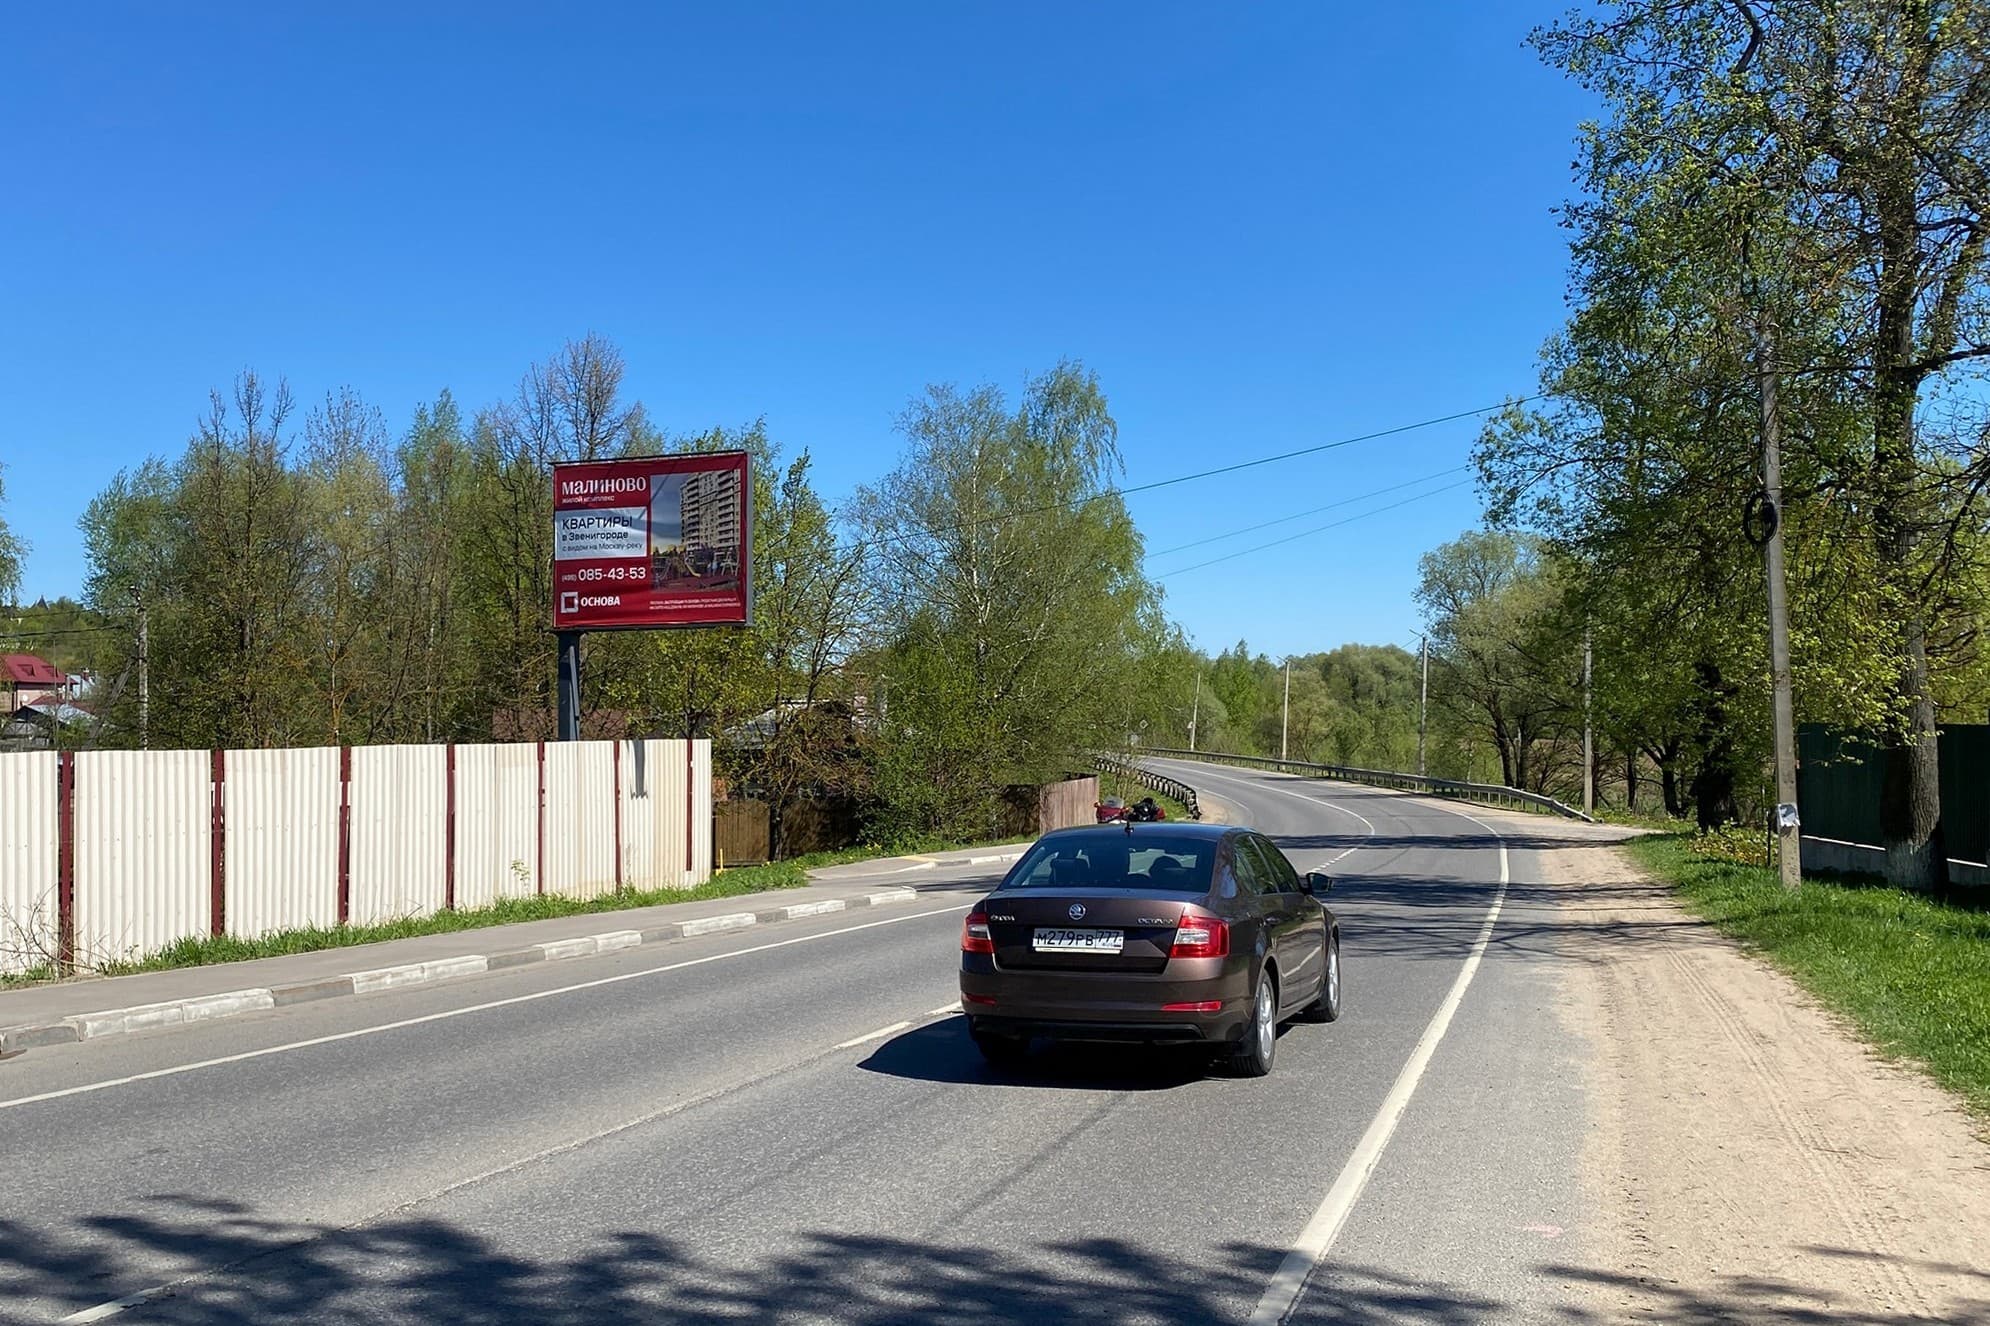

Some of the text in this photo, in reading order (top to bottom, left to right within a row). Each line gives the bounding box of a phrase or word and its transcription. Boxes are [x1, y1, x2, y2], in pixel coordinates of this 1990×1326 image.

[562, 516, 633, 530] КВАРТИРЫ
[569, 531, 629, 542] Звенигороде
[578, 567, 646, 581] 085-43-53
[580, 596, 621, 607] ОСНОВА
